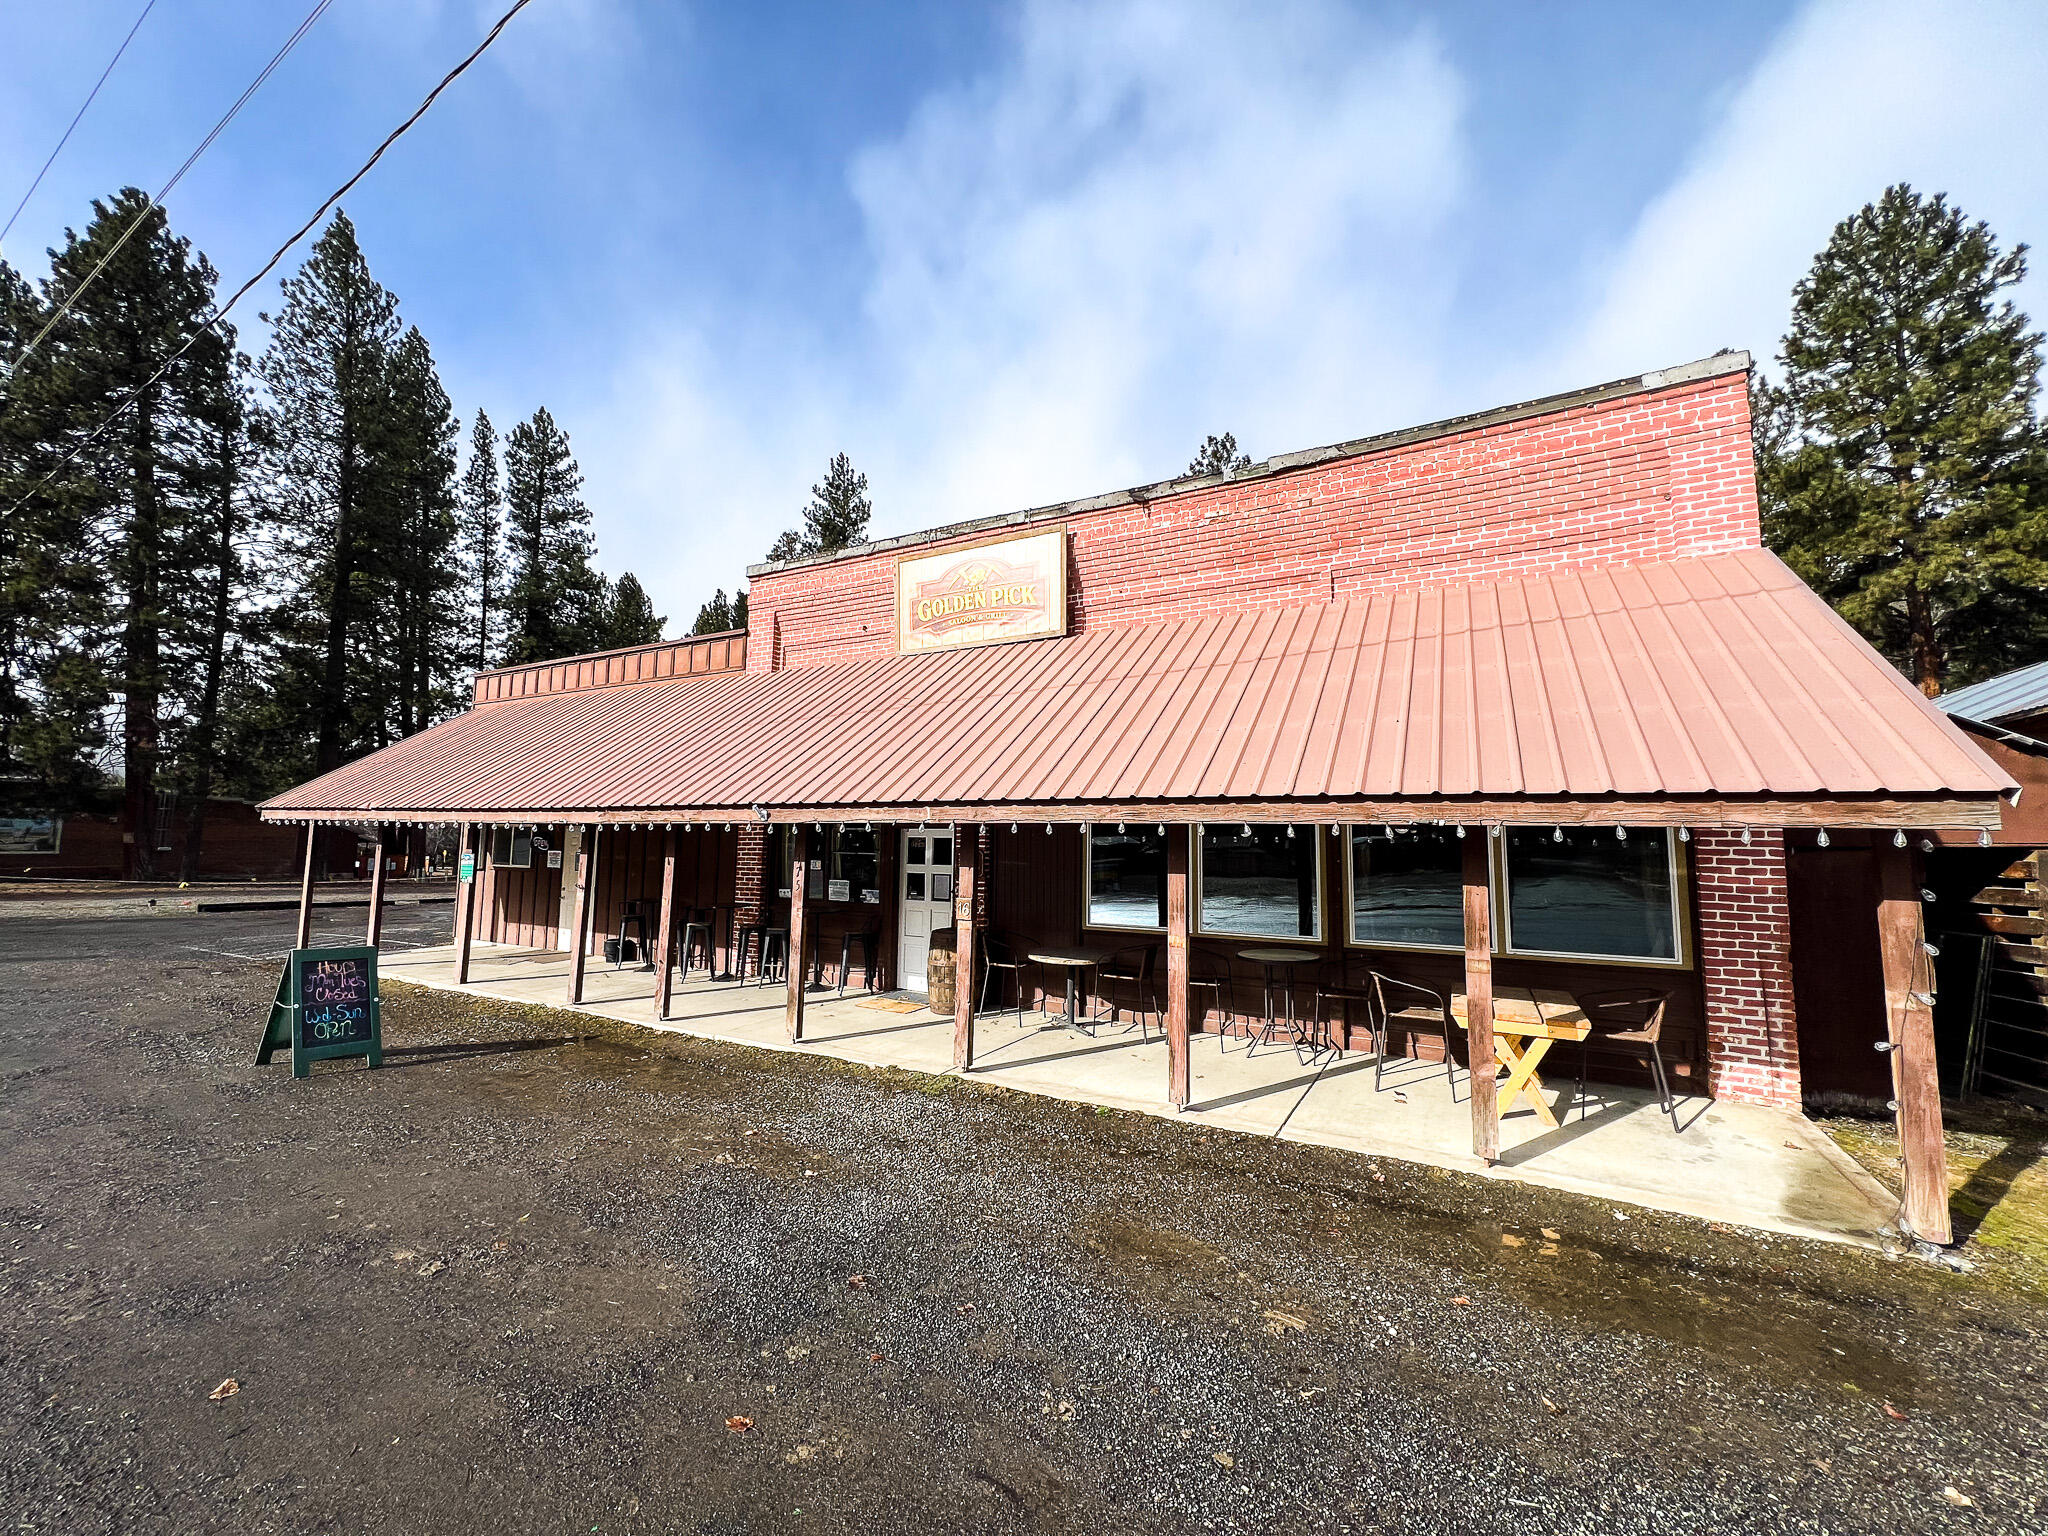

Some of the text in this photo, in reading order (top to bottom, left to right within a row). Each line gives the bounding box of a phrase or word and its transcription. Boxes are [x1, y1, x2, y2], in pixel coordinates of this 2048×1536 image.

[917, 585, 1038, 622] GOLDEN PICK
[958, 902, 970, 916] 16
